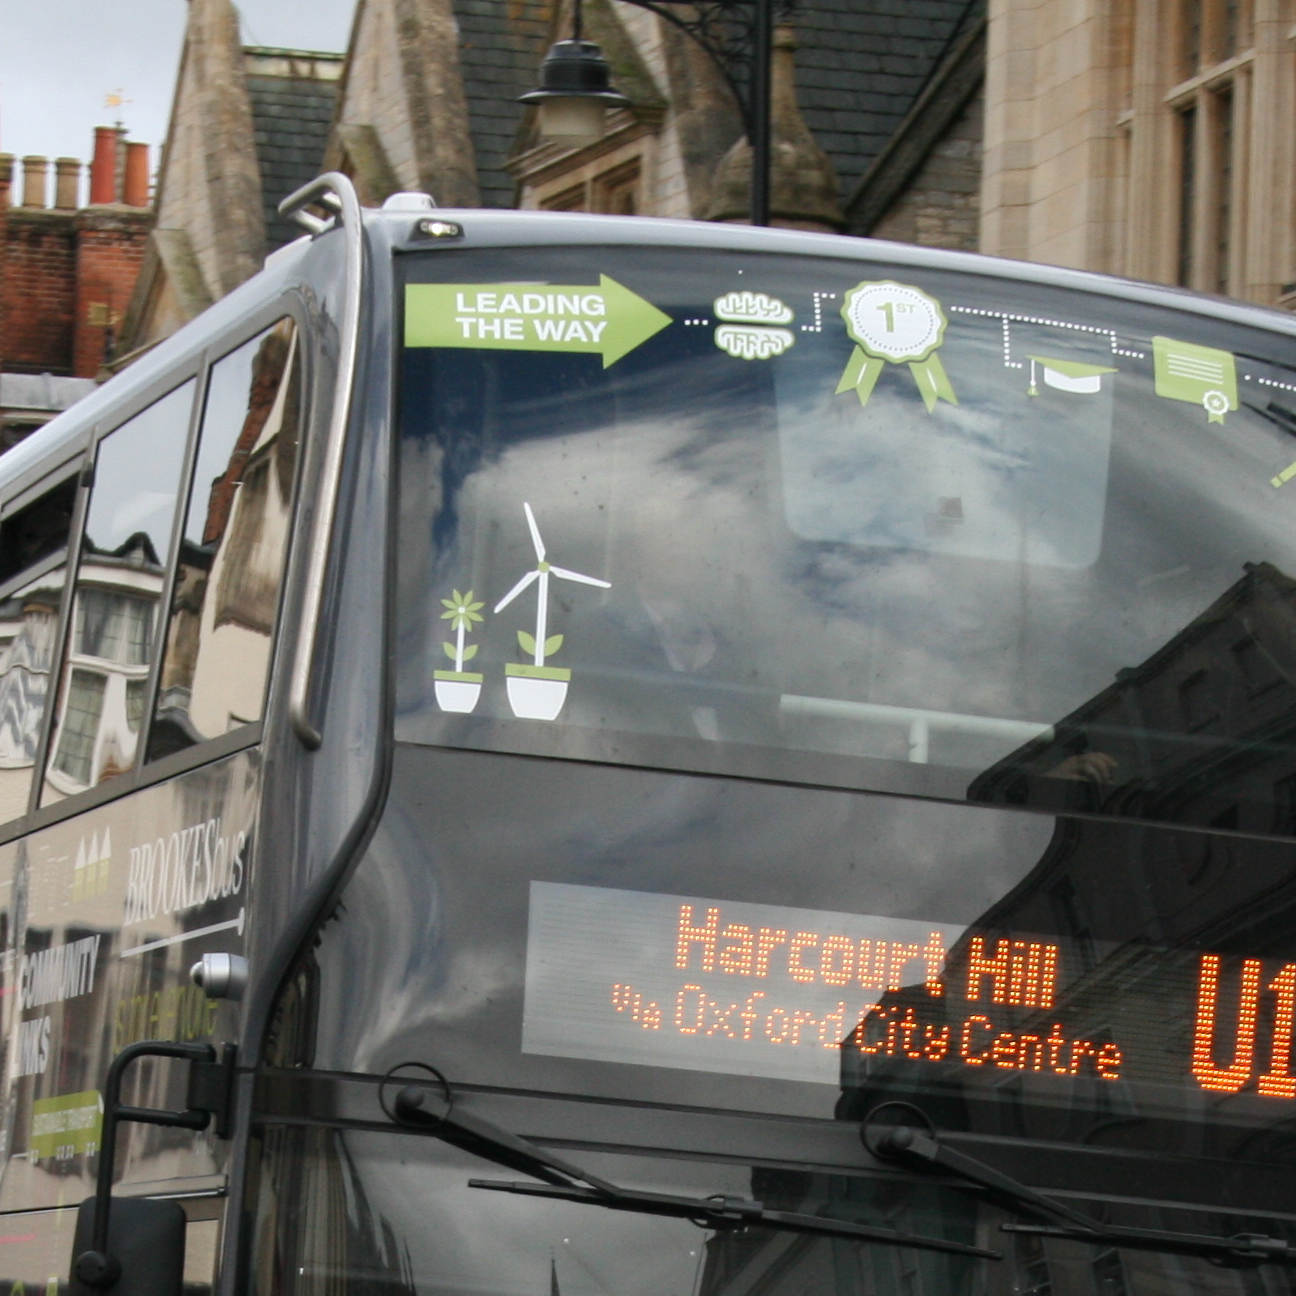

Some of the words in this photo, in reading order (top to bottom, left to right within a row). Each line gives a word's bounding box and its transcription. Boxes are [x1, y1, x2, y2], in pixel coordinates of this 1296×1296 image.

[454, 316, 525, 341] THE
[533, 319, 608, 343] WAY
[455, 292, 605, 316] LEADING
[876, 302, 916, 333] 1ST
[123, 817, 246, 927] BROOKESbus
[17, 933, 102, 1012] COMMUNITY
[674, 904, 946, 997] Harcourt
[965, 935, 1059, 1010] Hill
[675, 983, 846, 1050] Oxford
[855, 1003, 950, 1061] City
[960, 1014, 1122, 1079] Centre
